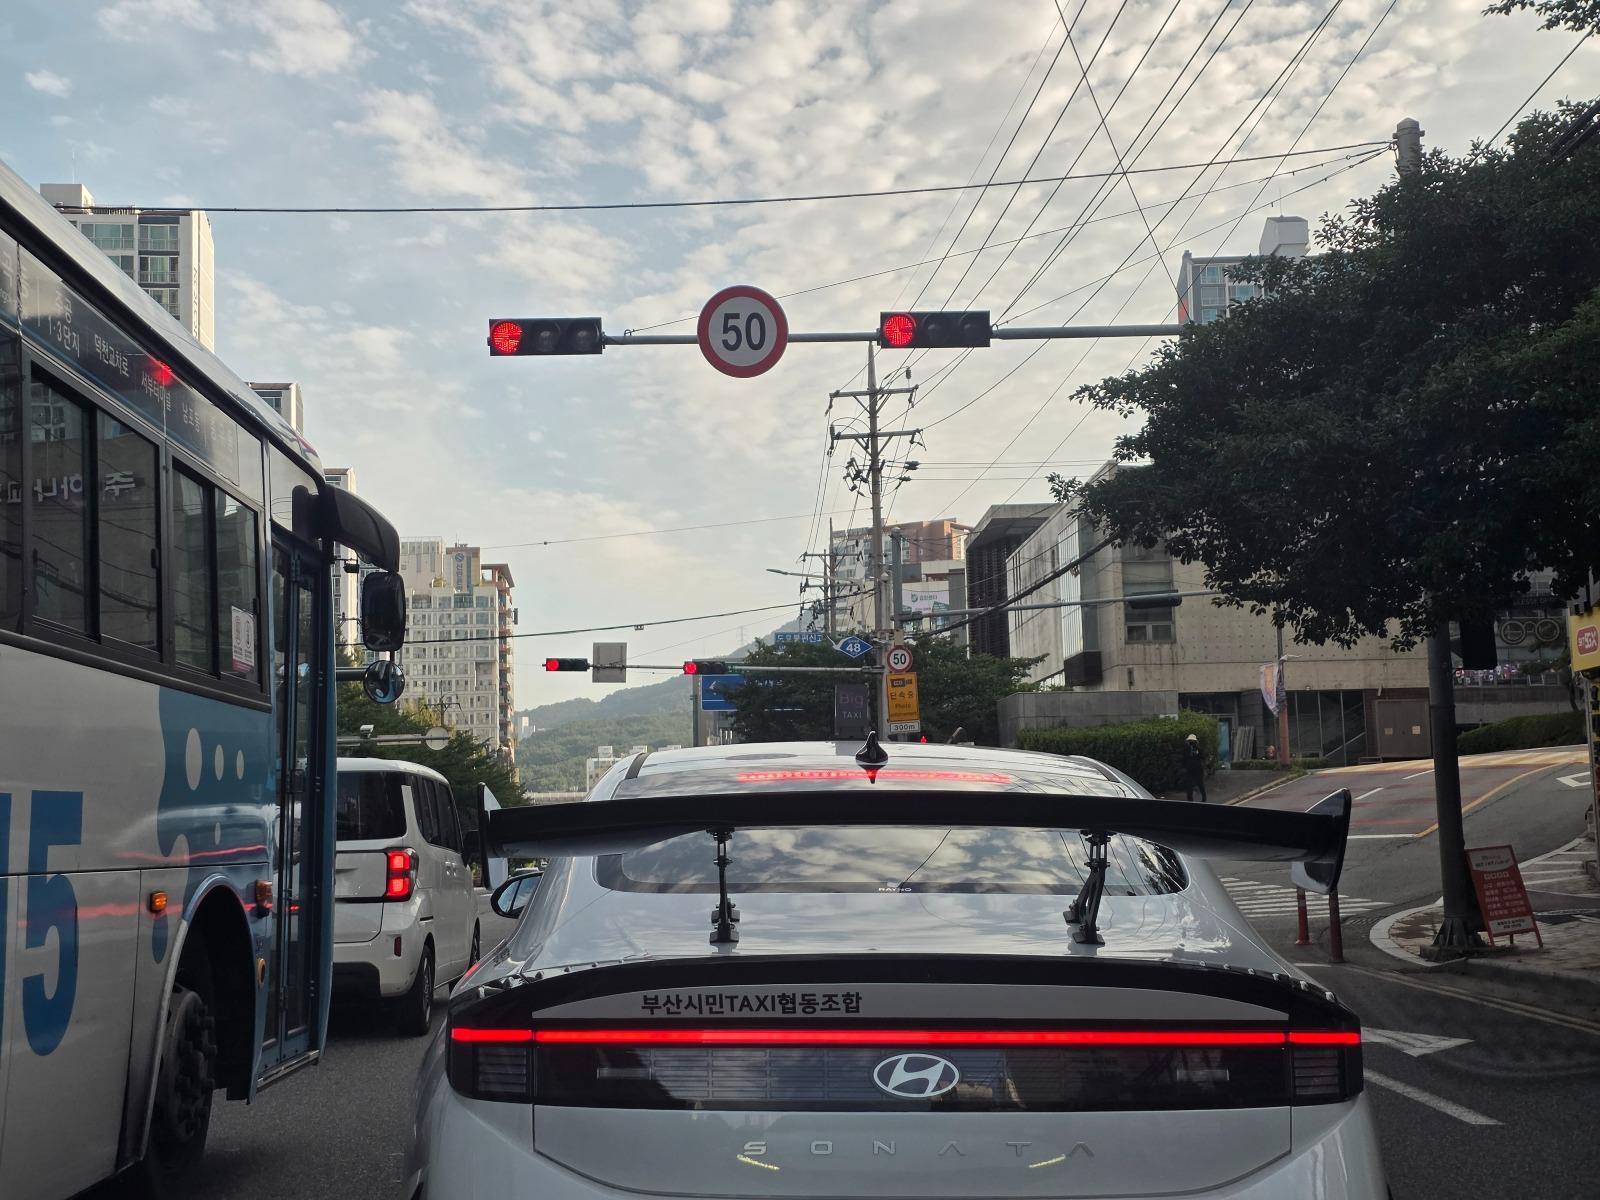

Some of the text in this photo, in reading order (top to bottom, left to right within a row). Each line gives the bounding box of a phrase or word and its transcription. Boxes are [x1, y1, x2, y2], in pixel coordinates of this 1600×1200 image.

[721, 312, 766, 351] 50
[846, 643, 861, 653] 48
[893, 653, 907, 665] 50
[842, 711, 862, 719] TAXI
[894, 723, 916, 731] 300m
[641, 991, 863, 1016] 부산시민TAXI협동조합
[742, 1140, 1095, 1159] SONATA
